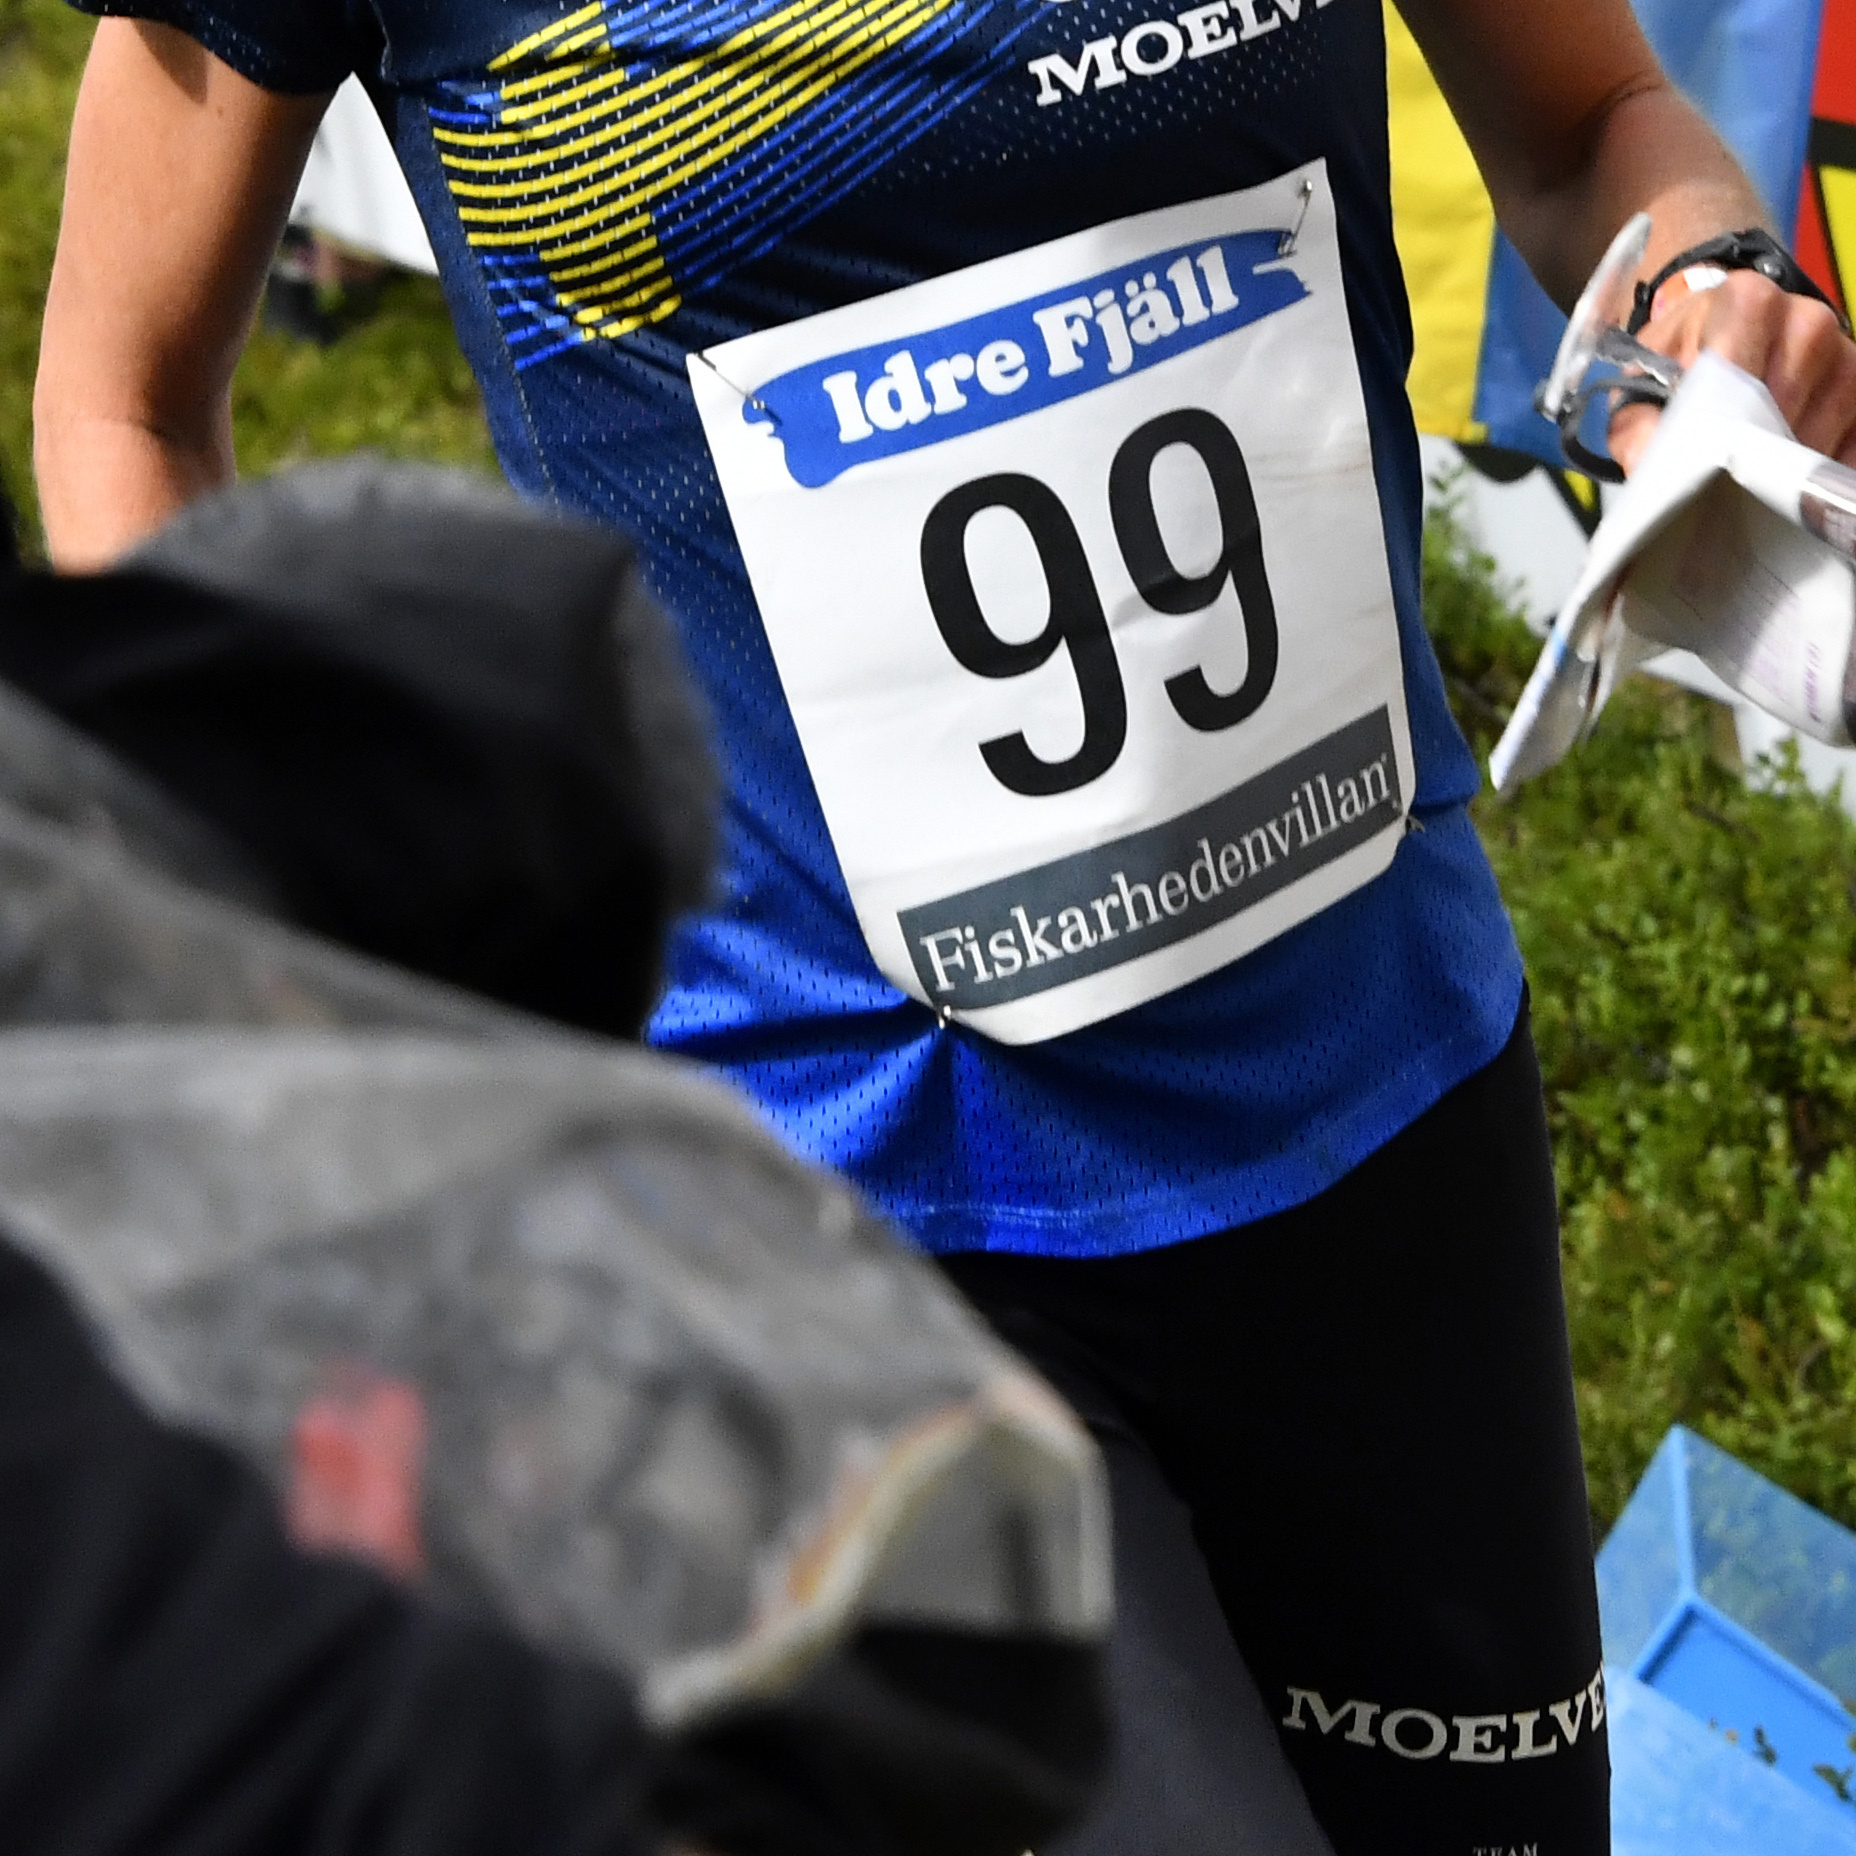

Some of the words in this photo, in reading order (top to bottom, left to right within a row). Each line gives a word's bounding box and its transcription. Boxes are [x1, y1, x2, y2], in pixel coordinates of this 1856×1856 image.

[823, 338, 1030, 446] Idre
[1034, 245, 1241, 378] Fjäll
[919, 406, 1282, 797] 99
[919, 758, 1394, 994] Fiskarhedenvillan
